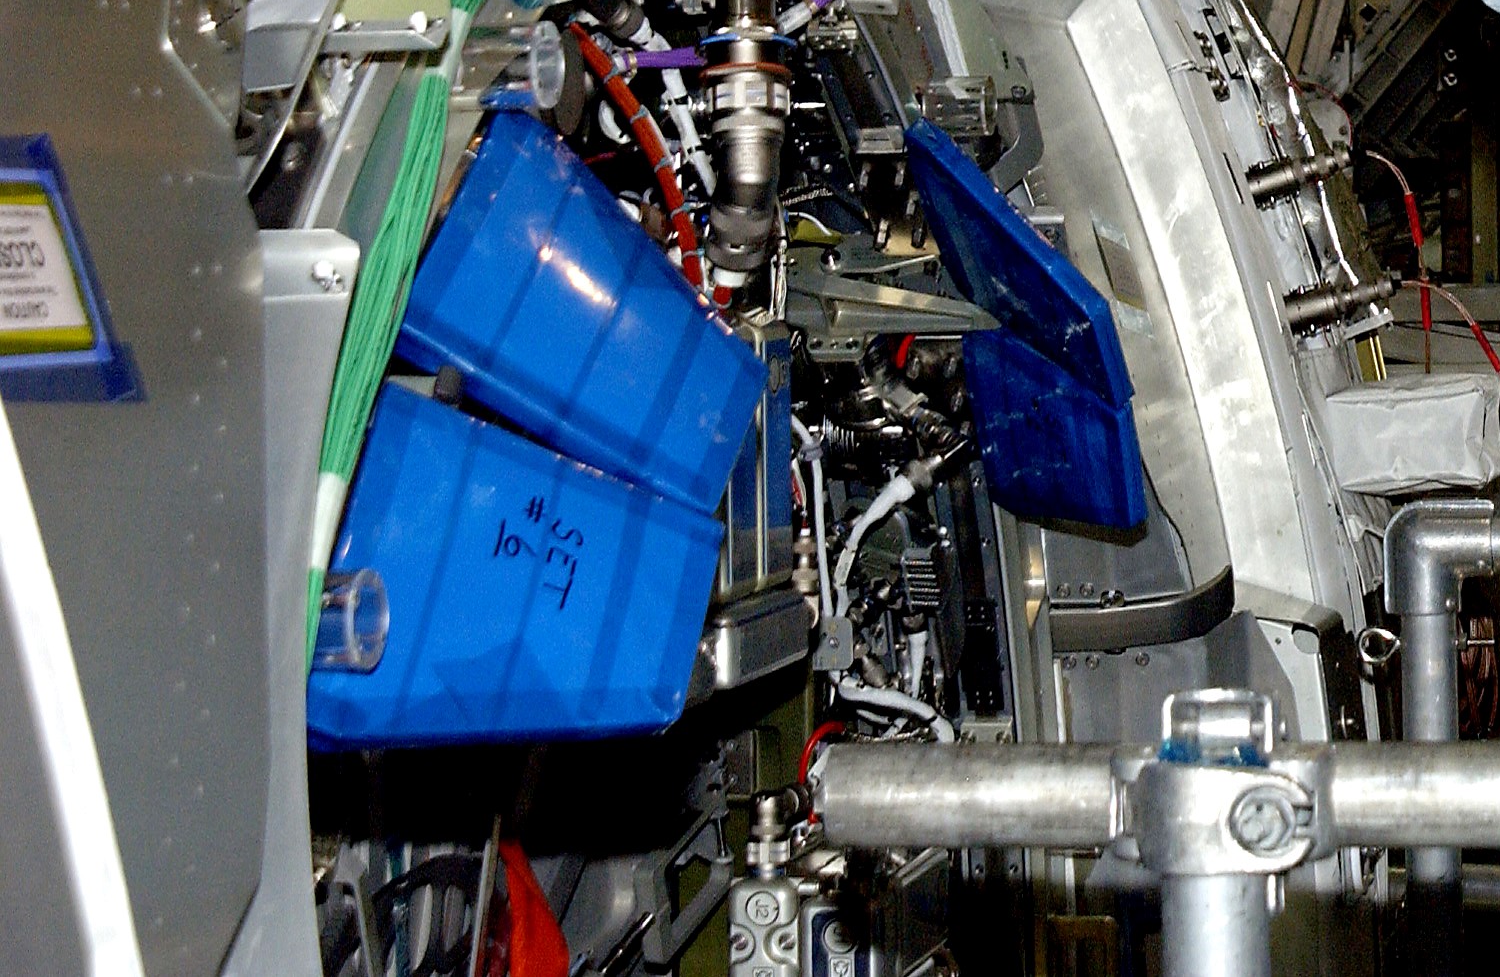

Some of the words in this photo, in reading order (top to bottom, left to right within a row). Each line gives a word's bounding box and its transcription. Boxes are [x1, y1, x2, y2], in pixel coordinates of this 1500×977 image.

[0, 241, 45, 268] CLOS
[543, 518, 584, 610] SET
[755, 898, 770, 919] J2
